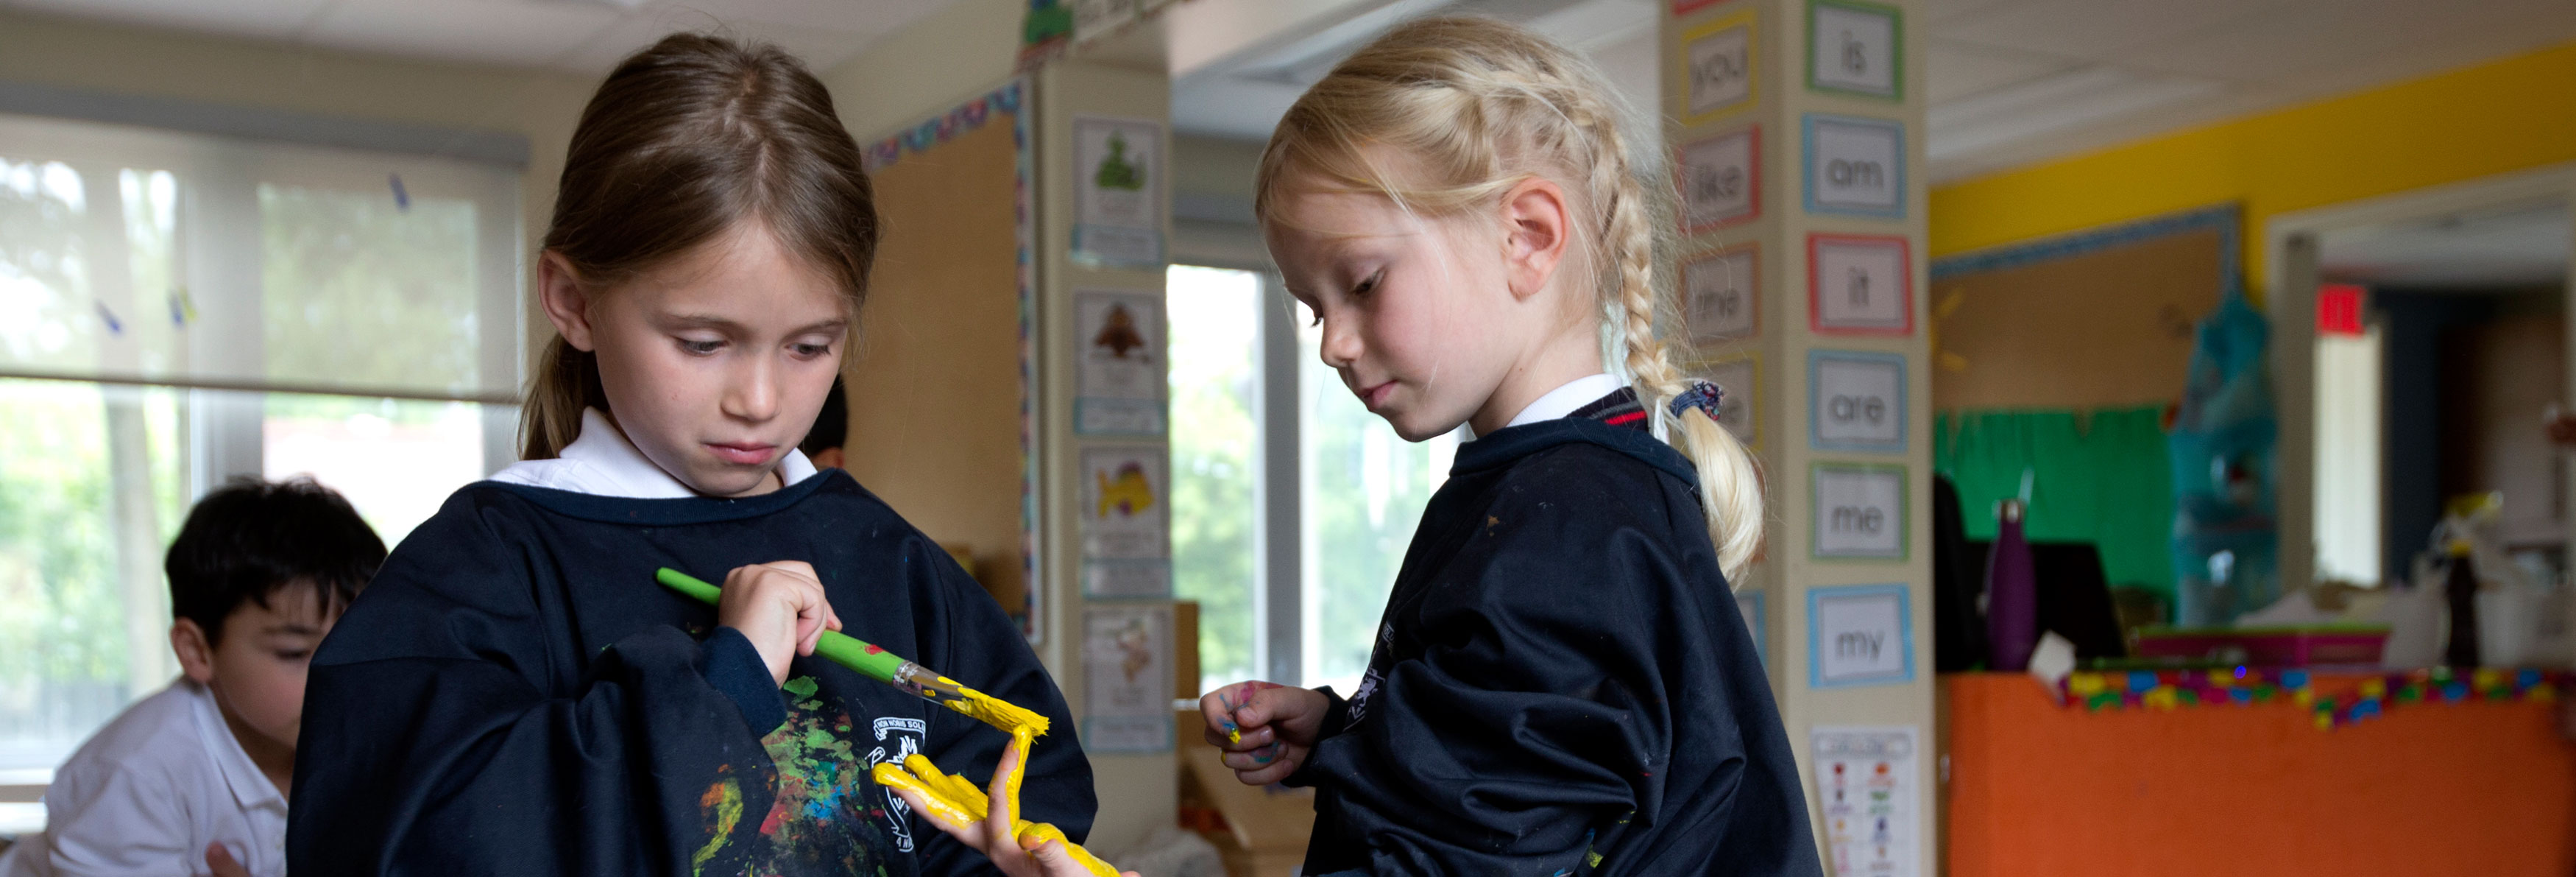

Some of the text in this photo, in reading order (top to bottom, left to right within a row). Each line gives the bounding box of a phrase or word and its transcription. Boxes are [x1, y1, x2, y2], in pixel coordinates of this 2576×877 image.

[1843, 29, 1868, 75] is
[1691, 50, 1748, 97] you
[1696, 163, 1743, 202] like
[1827, 158, 1884, 189] am
[1847, 266, 1870, 307] it
[1828, 395, 1886, 426] are
[1831, 505, 1884, 535] me
[1836, 630, 1885, 664] my
